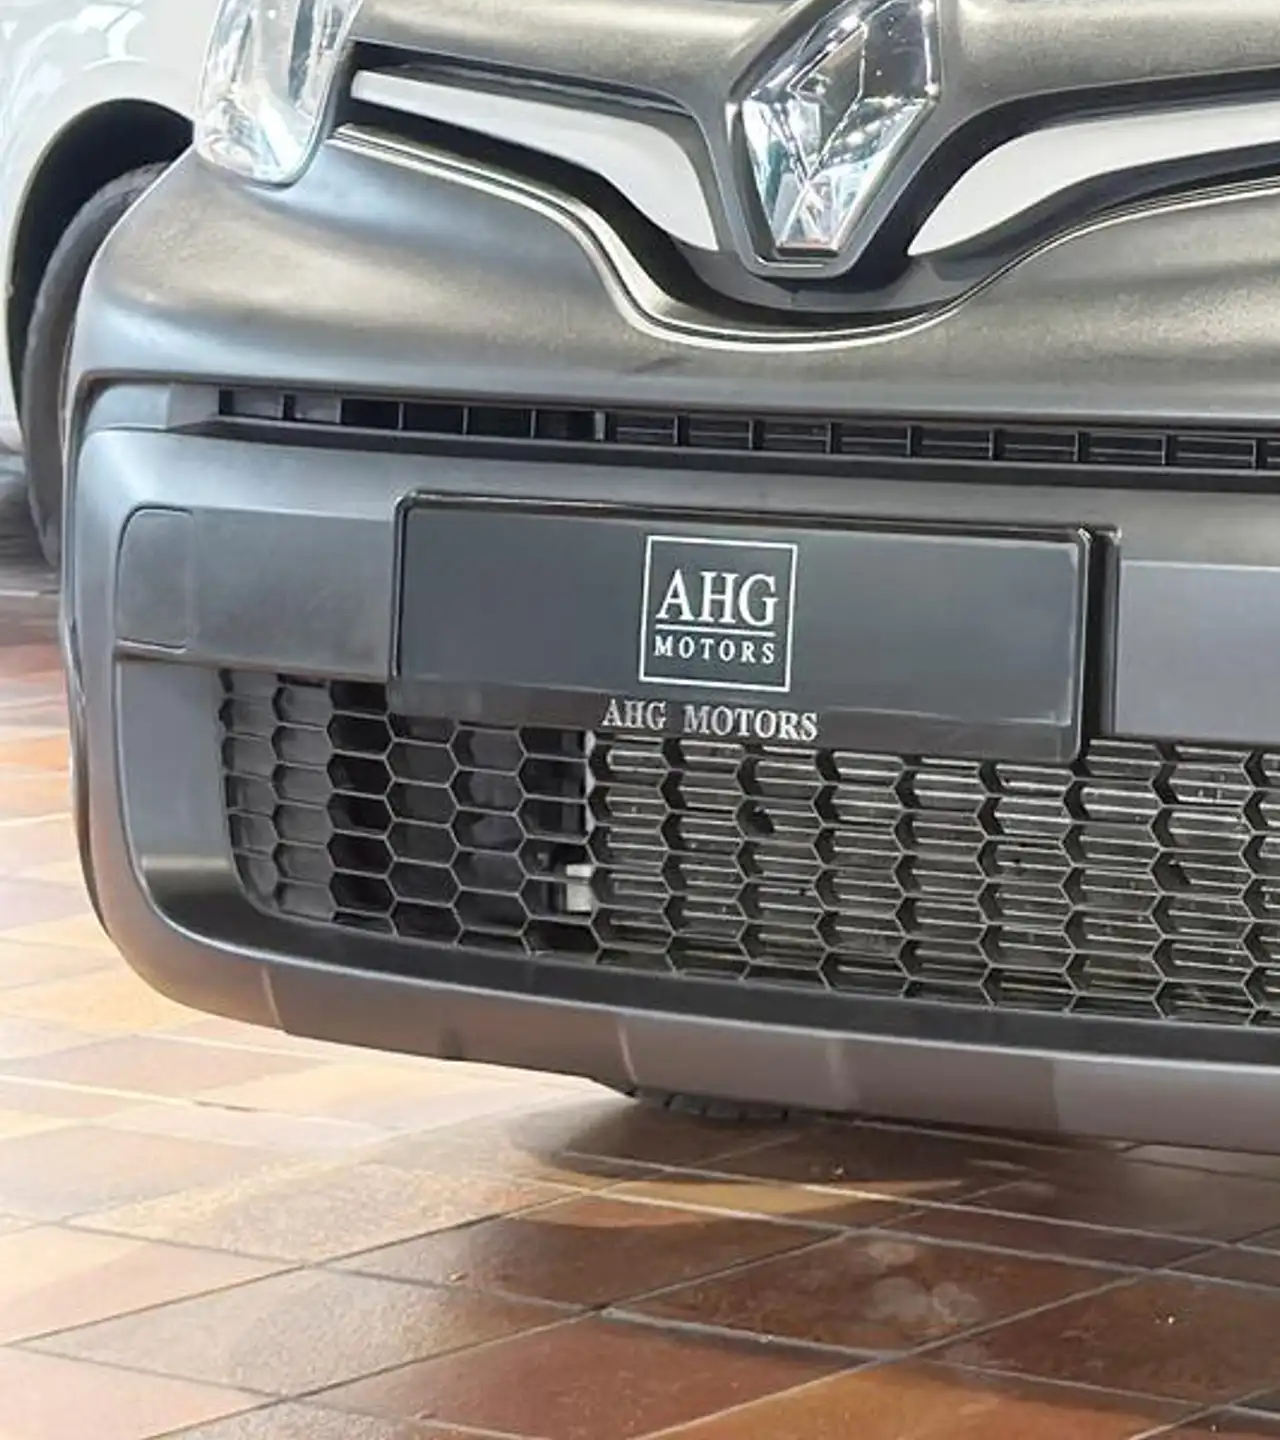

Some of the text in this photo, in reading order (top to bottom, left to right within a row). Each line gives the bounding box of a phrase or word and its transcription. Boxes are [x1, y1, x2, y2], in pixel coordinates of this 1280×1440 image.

[655, 568, 780, 627] AHG
[653, 634, 776, 665] MOTORS
[601, 698, 819, 742] AHG MOTORS
